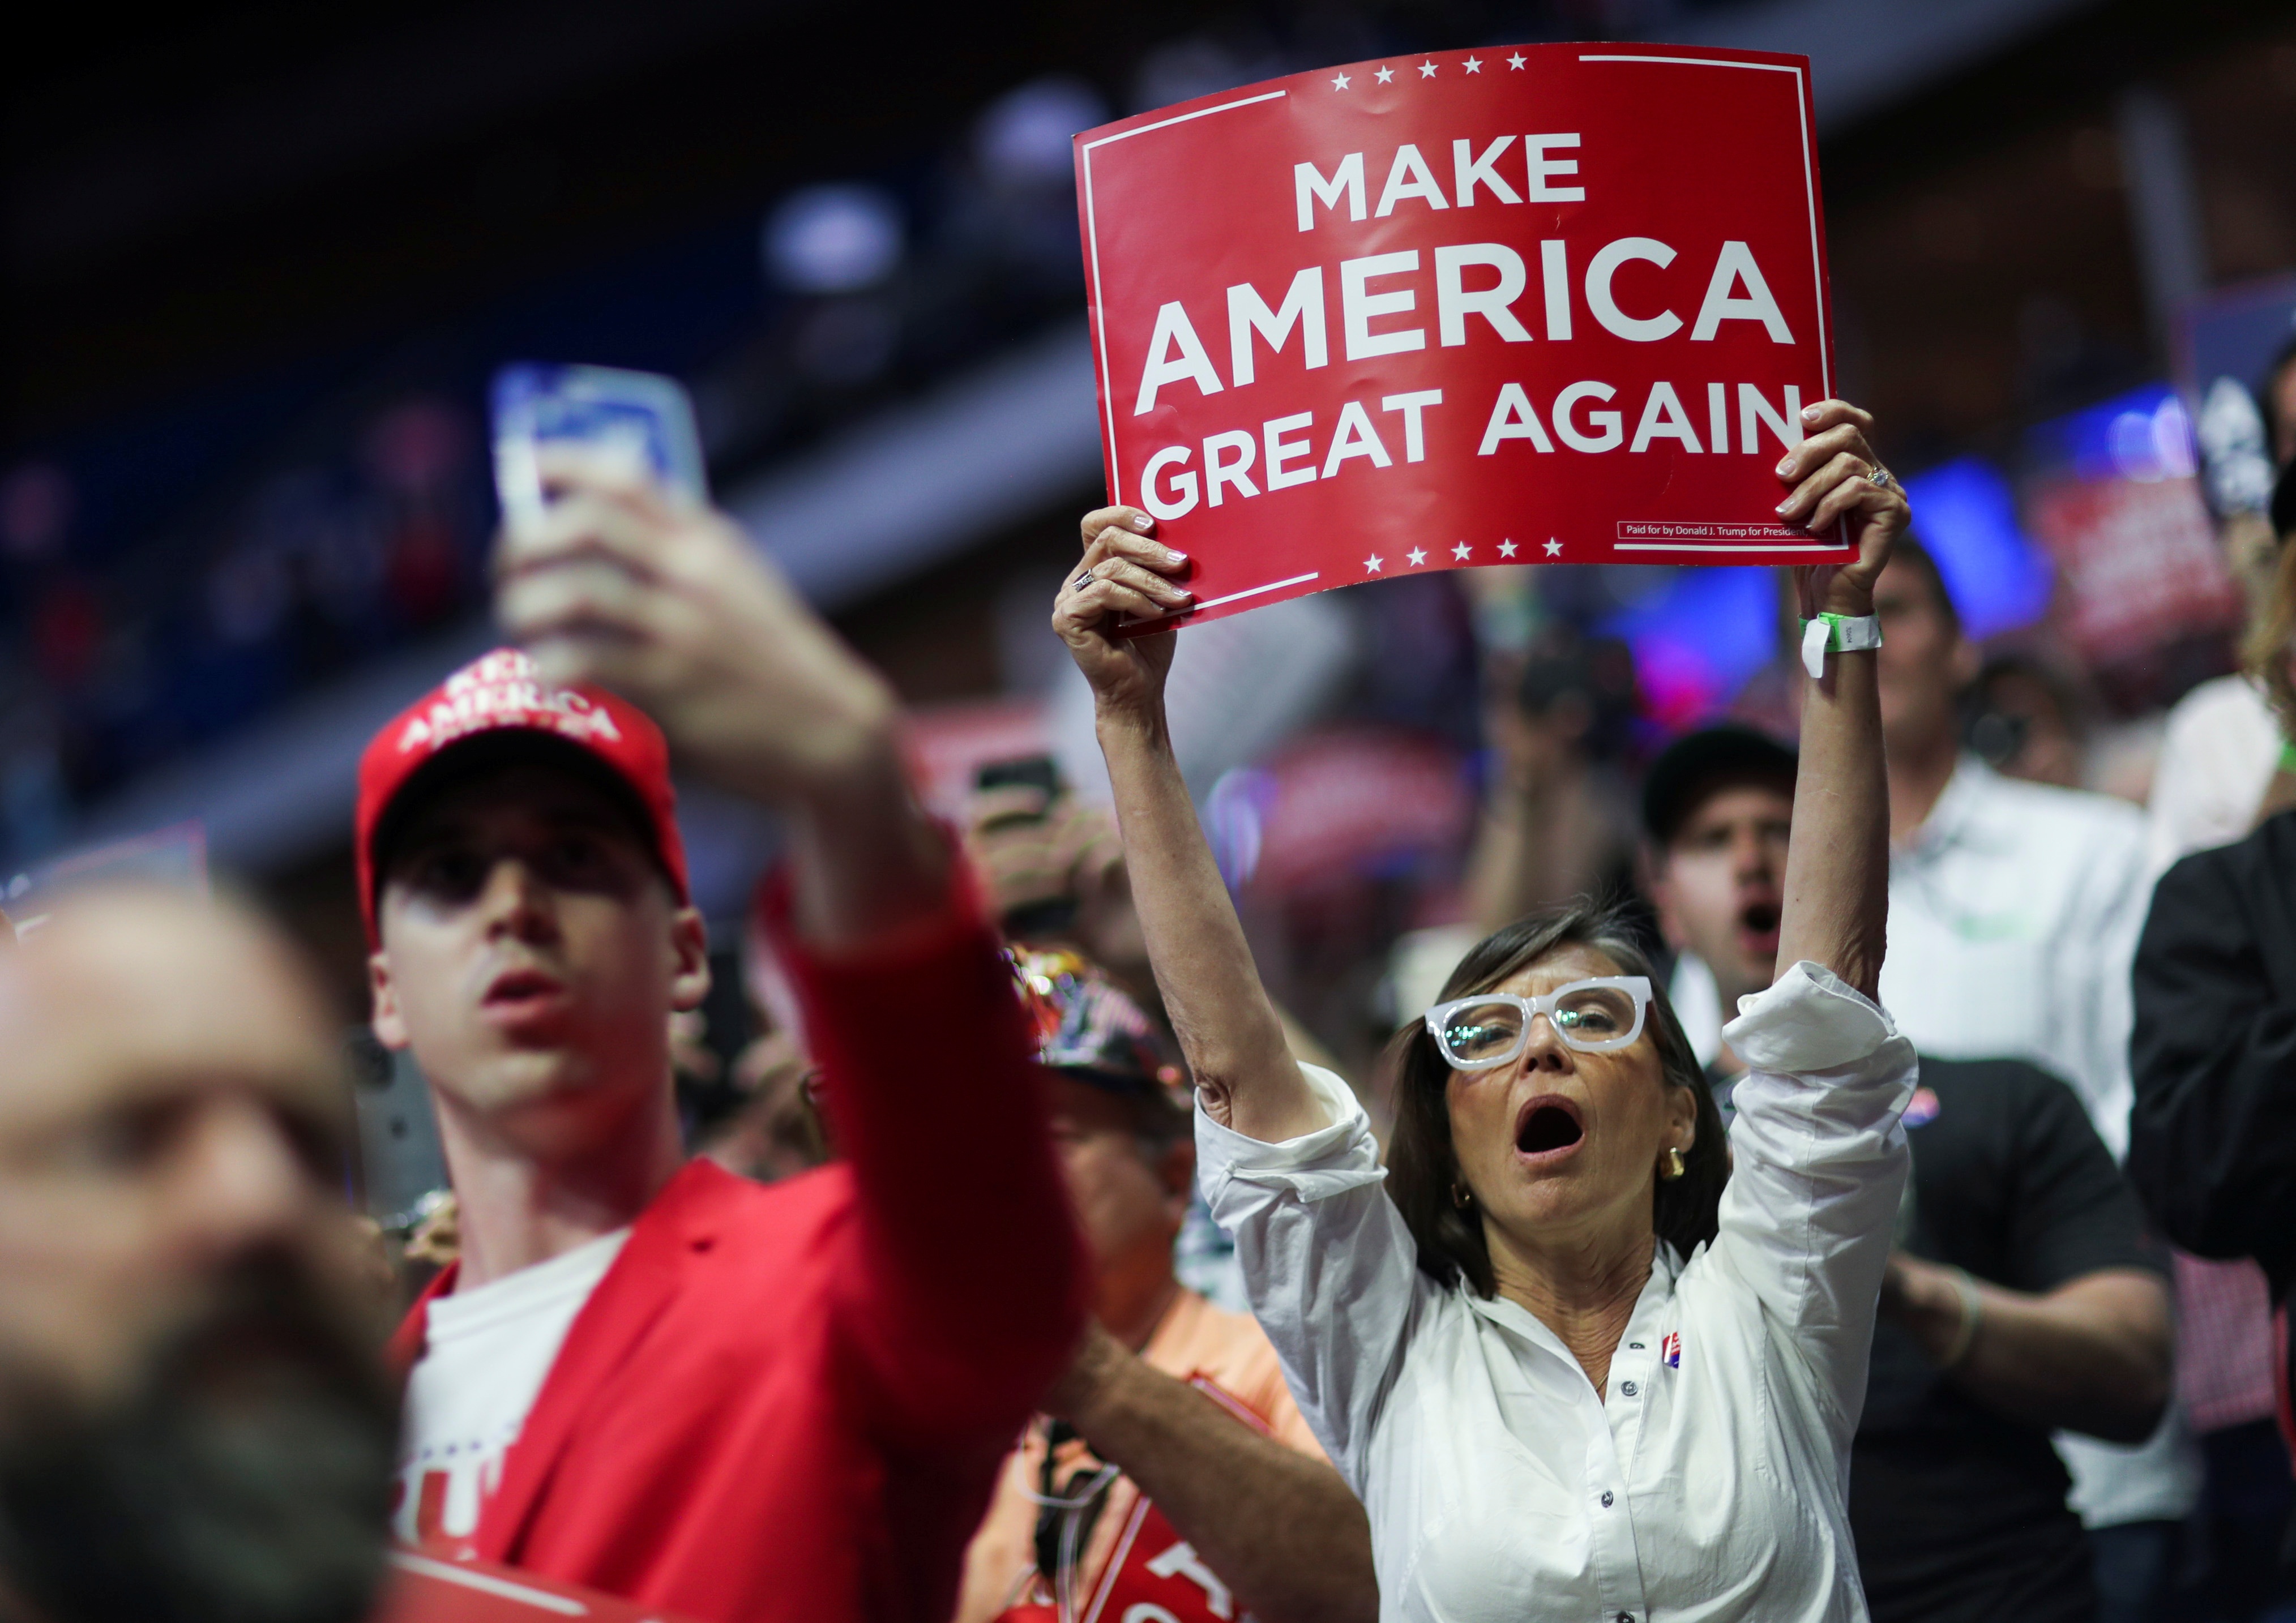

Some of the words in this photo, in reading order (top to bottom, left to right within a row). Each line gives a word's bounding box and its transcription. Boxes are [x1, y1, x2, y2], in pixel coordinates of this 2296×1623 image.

[1294, 133, 1586, 233] MAKE
[1134, 237, 1796, 417] AMERICA
[1141, 389, 1443, 521] GREAT
[1478, 381, 1801, 455] AGAIN
[1627, 525, 1646, 534] Paid
[1648, 525, 1660, 534] for
[1663, 525, 1674, 536] by
[1676, 526, 1707, 535] Donald
[1717, 527, 1746, 537] Trump
[1748, 526, 1761, 536] for
[1763, 527, 1808, 537] President,
